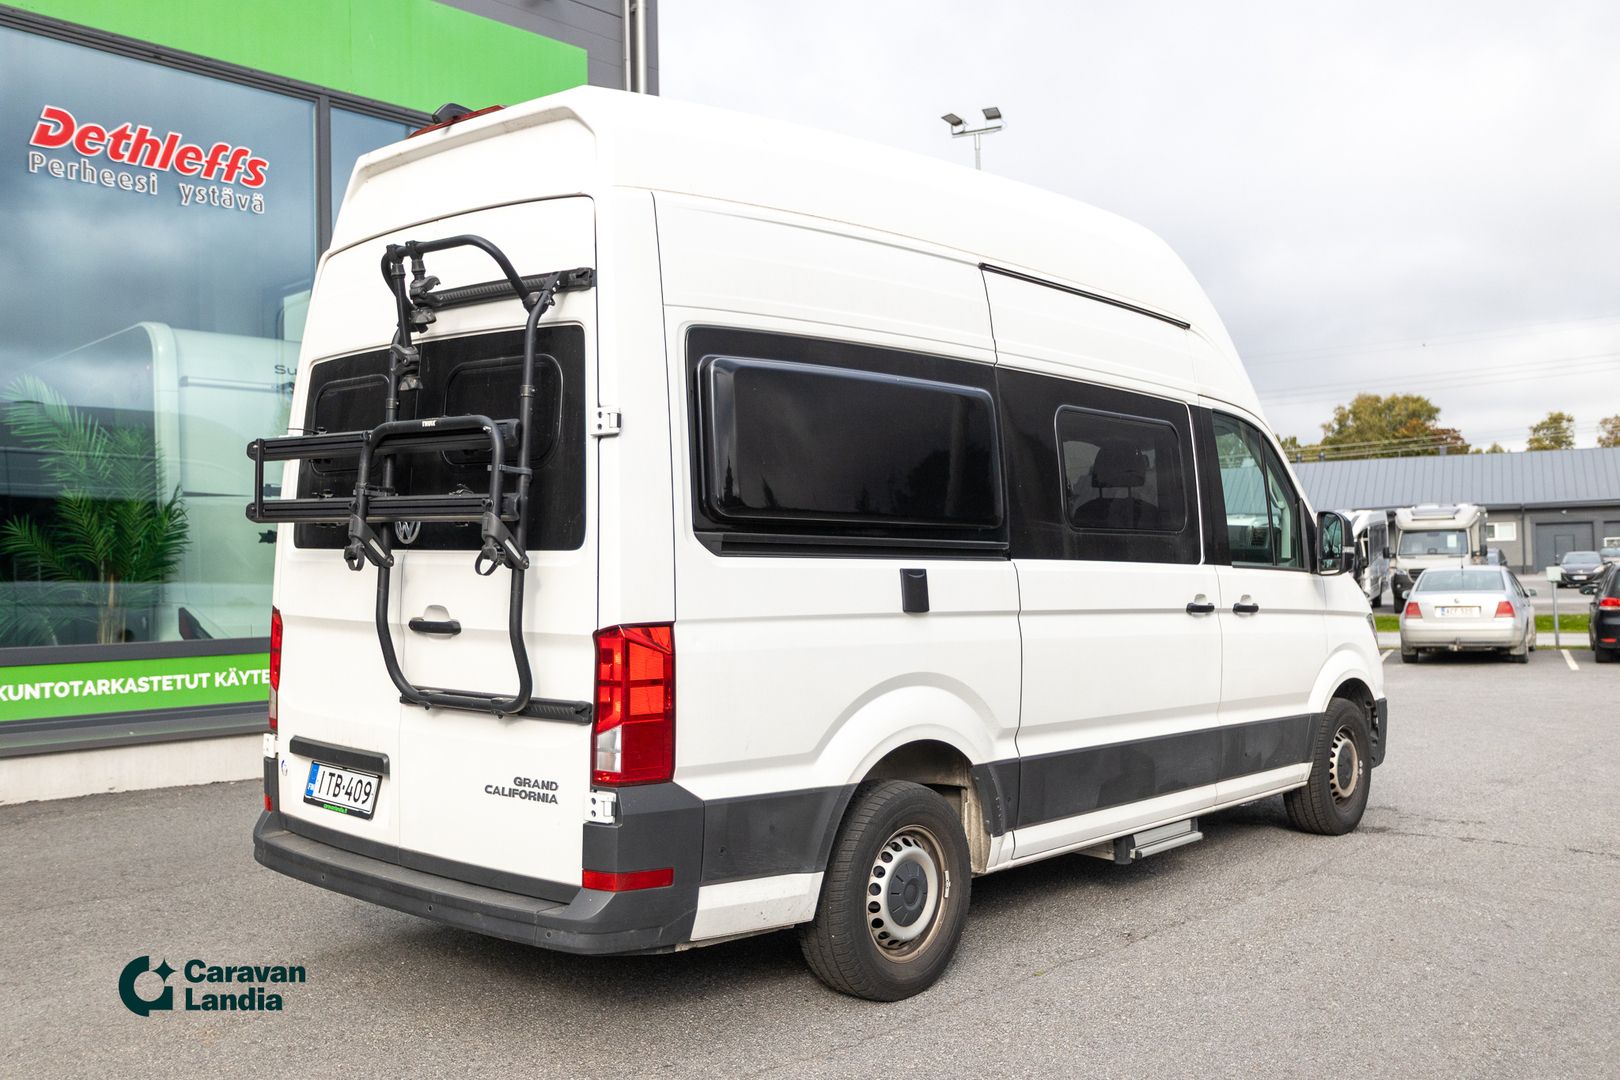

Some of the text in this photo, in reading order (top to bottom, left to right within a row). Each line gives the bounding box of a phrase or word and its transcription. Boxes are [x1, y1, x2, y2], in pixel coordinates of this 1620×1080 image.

[30, 104, 270, 188] Dethleffs
[28, 151, 265, 214] Perheesi ystävä
[0, 667, 270, 702] KUNTOTARKASTETUT KÄYTE
[318, 770, 372, 805] ITB-409
[484, 784, 559, 805] CALIFORNIA
[513, 776, 559, 791] GRAND
